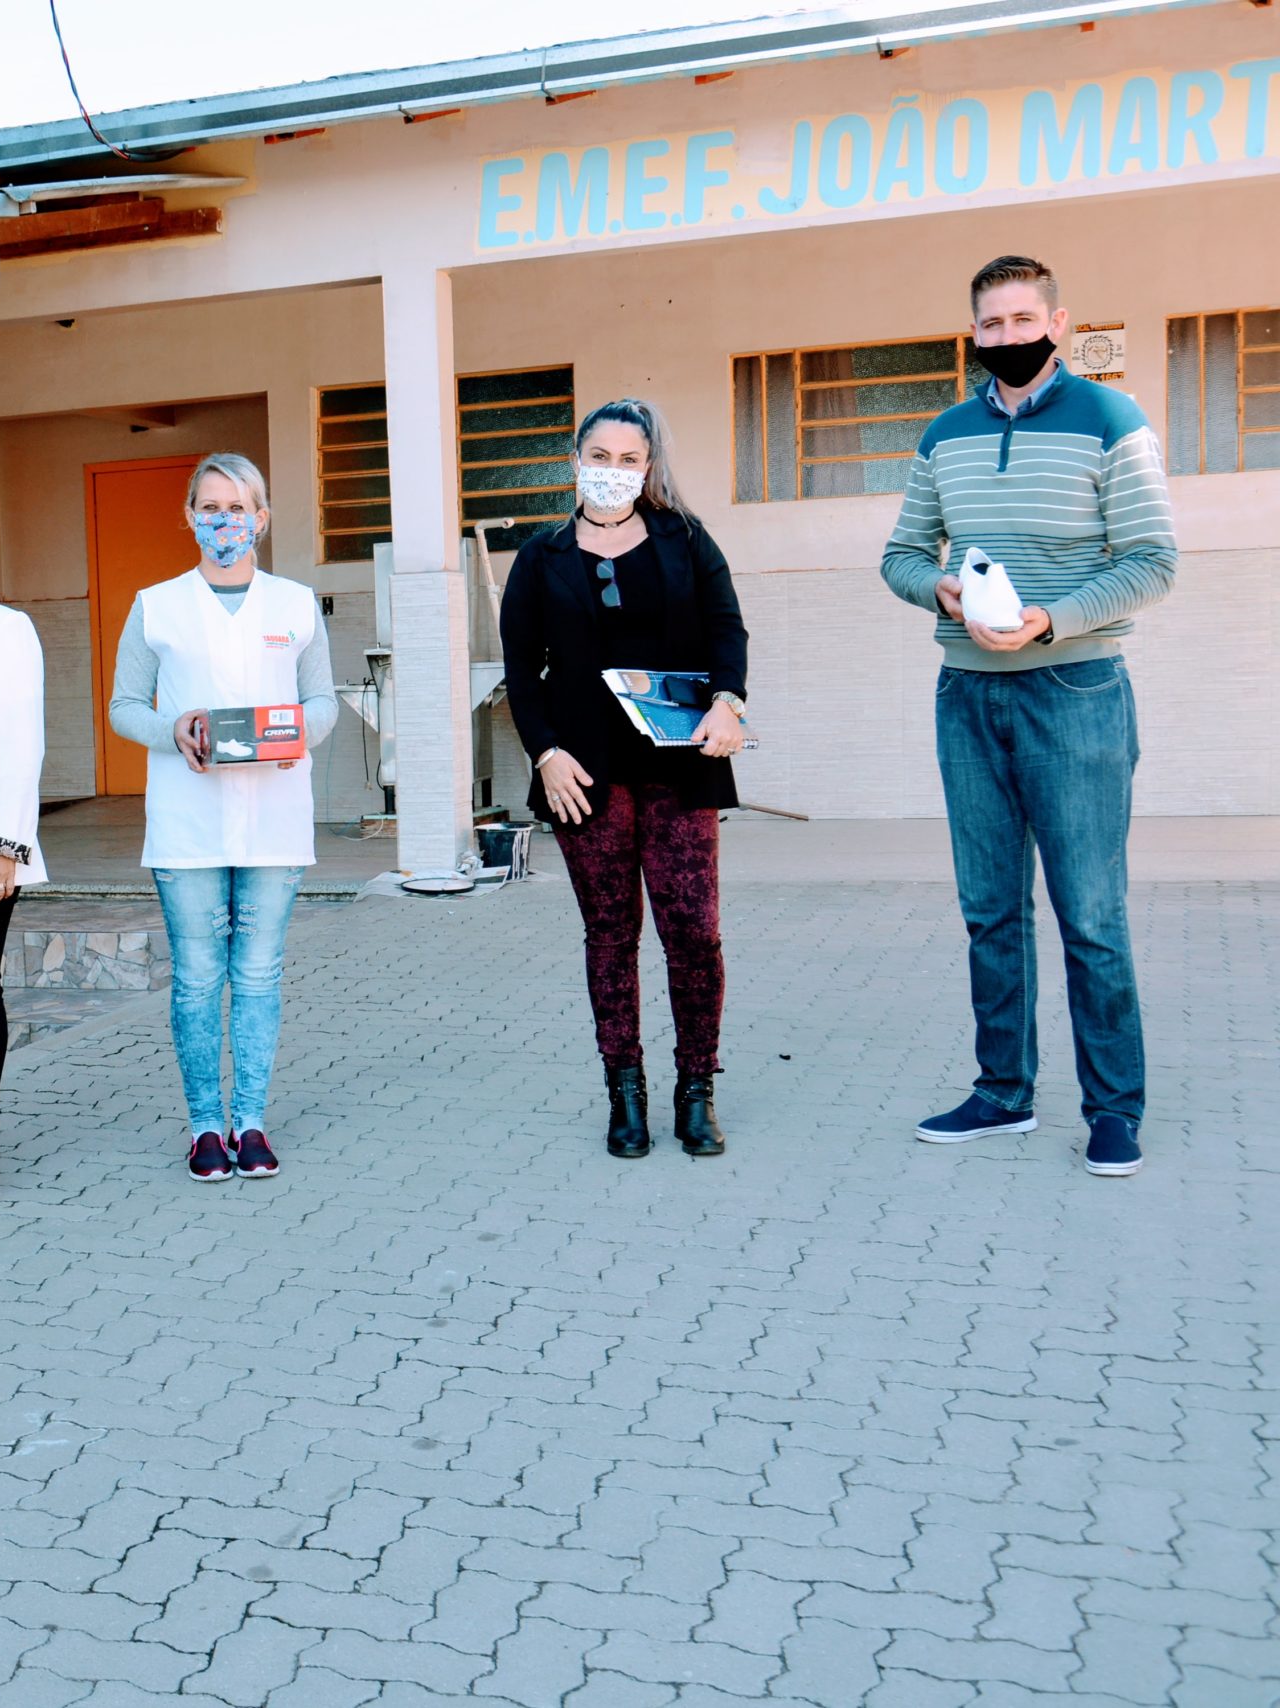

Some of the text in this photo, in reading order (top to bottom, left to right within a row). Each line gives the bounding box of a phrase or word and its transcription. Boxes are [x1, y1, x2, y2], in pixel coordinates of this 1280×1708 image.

[478, 58, 1280, 249] E.M.E.F. JOÃO MART
